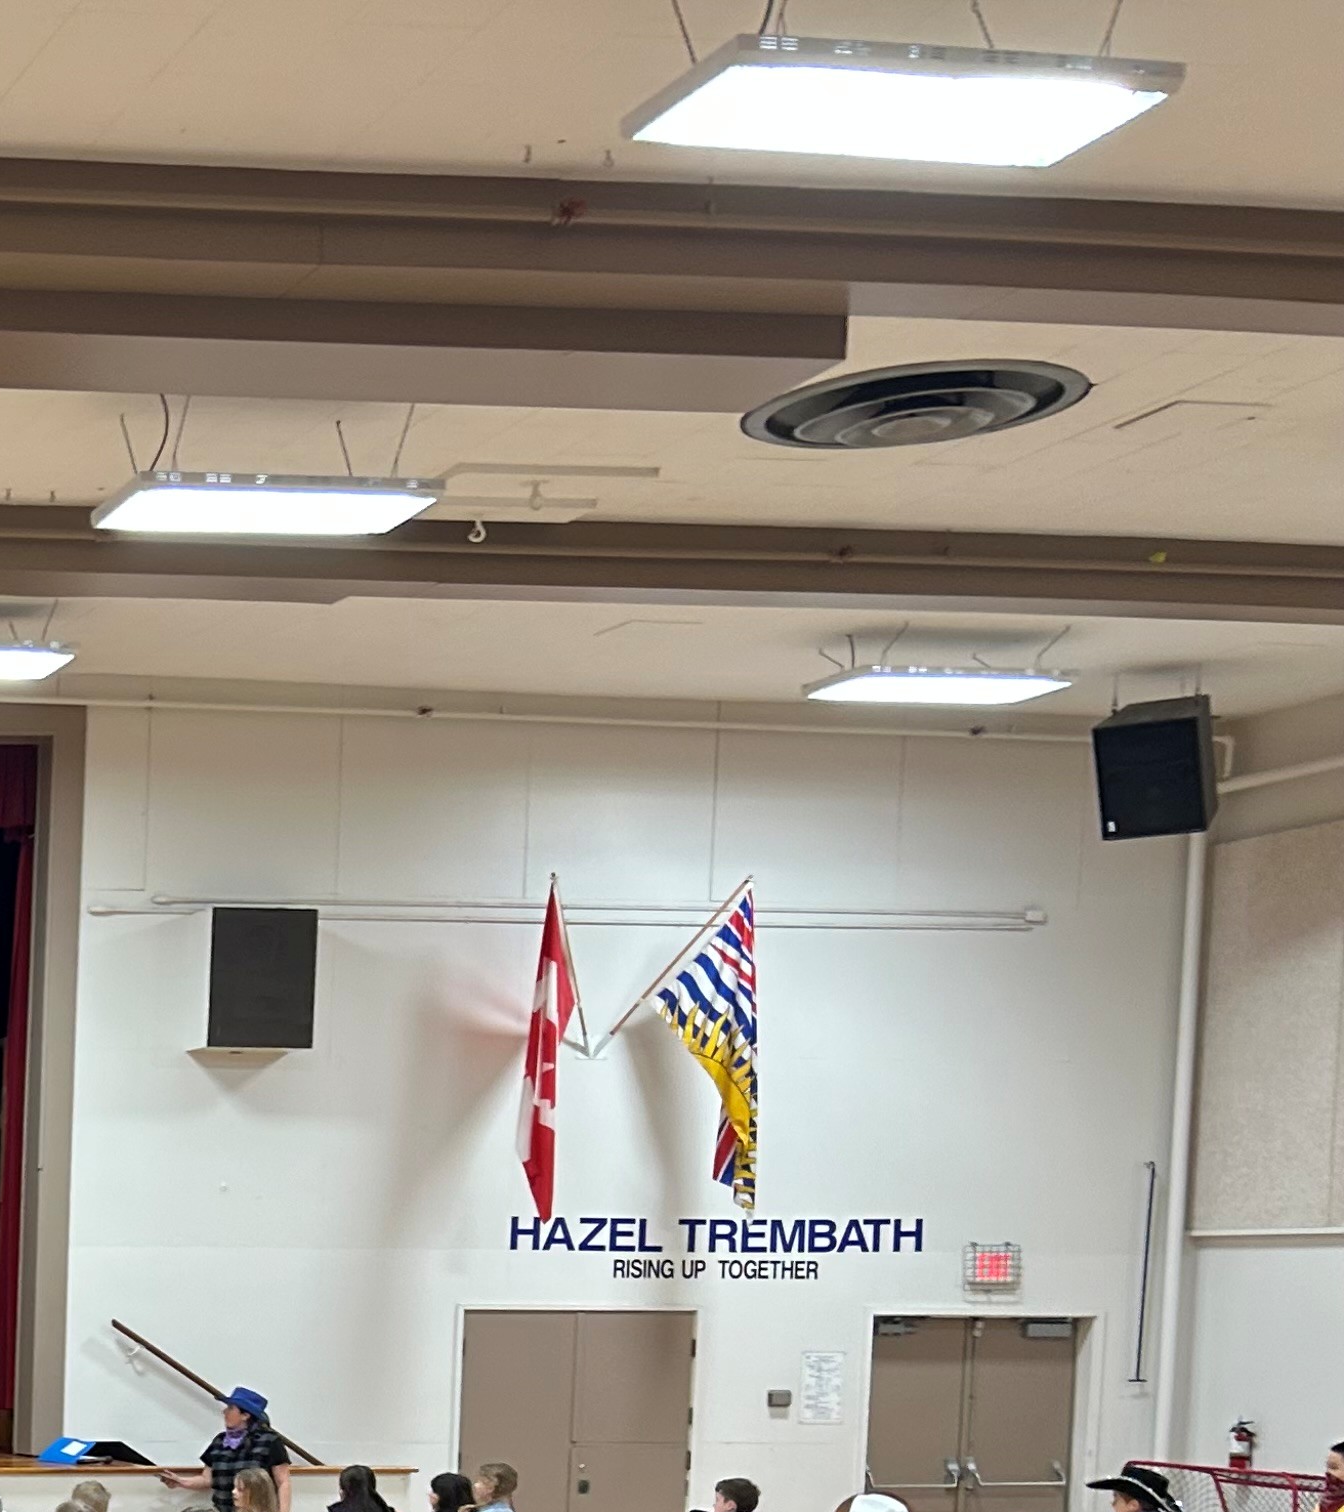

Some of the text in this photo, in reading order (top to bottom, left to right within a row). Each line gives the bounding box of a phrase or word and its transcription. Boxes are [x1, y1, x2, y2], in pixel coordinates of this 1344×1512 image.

[510, 1216, 923, 1254] HAZEL TREMBATH
[613, 1260, 819, 1280] RISING UP TOGETHER
